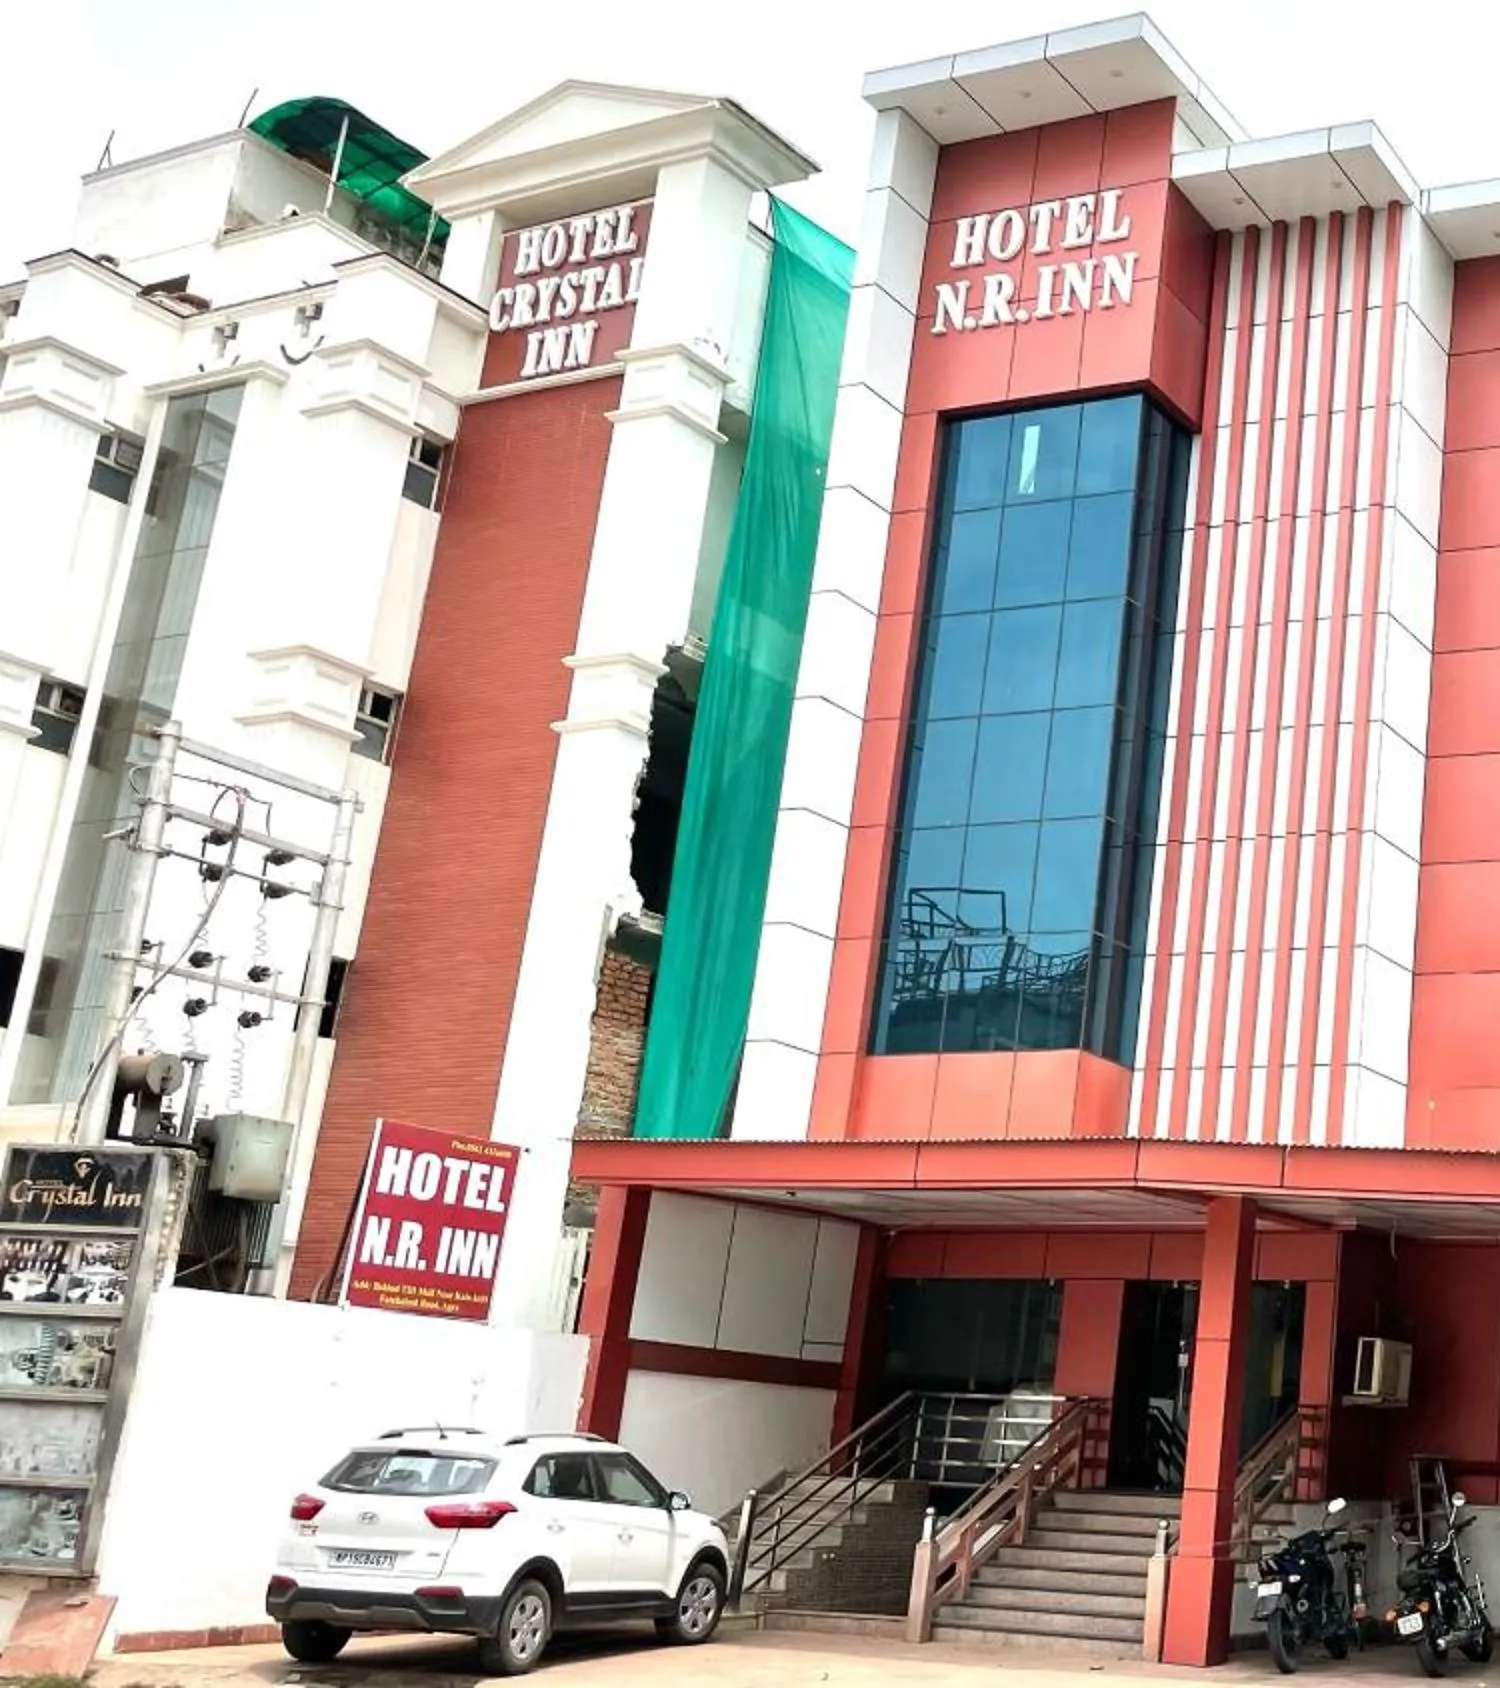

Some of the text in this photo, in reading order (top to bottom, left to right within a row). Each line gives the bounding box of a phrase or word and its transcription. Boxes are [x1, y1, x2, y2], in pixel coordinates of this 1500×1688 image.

[513, 207, 639, 276] HOTEL
[950, 189, 1132, 269] HOTEL
[520, 320, 599, 378] INN
[9, 1172, 141, 1223] Crystal Inn
[375, 1145, 507, 1213] HOTEL
[359, 1215, 500, 1280] N.R. INN
